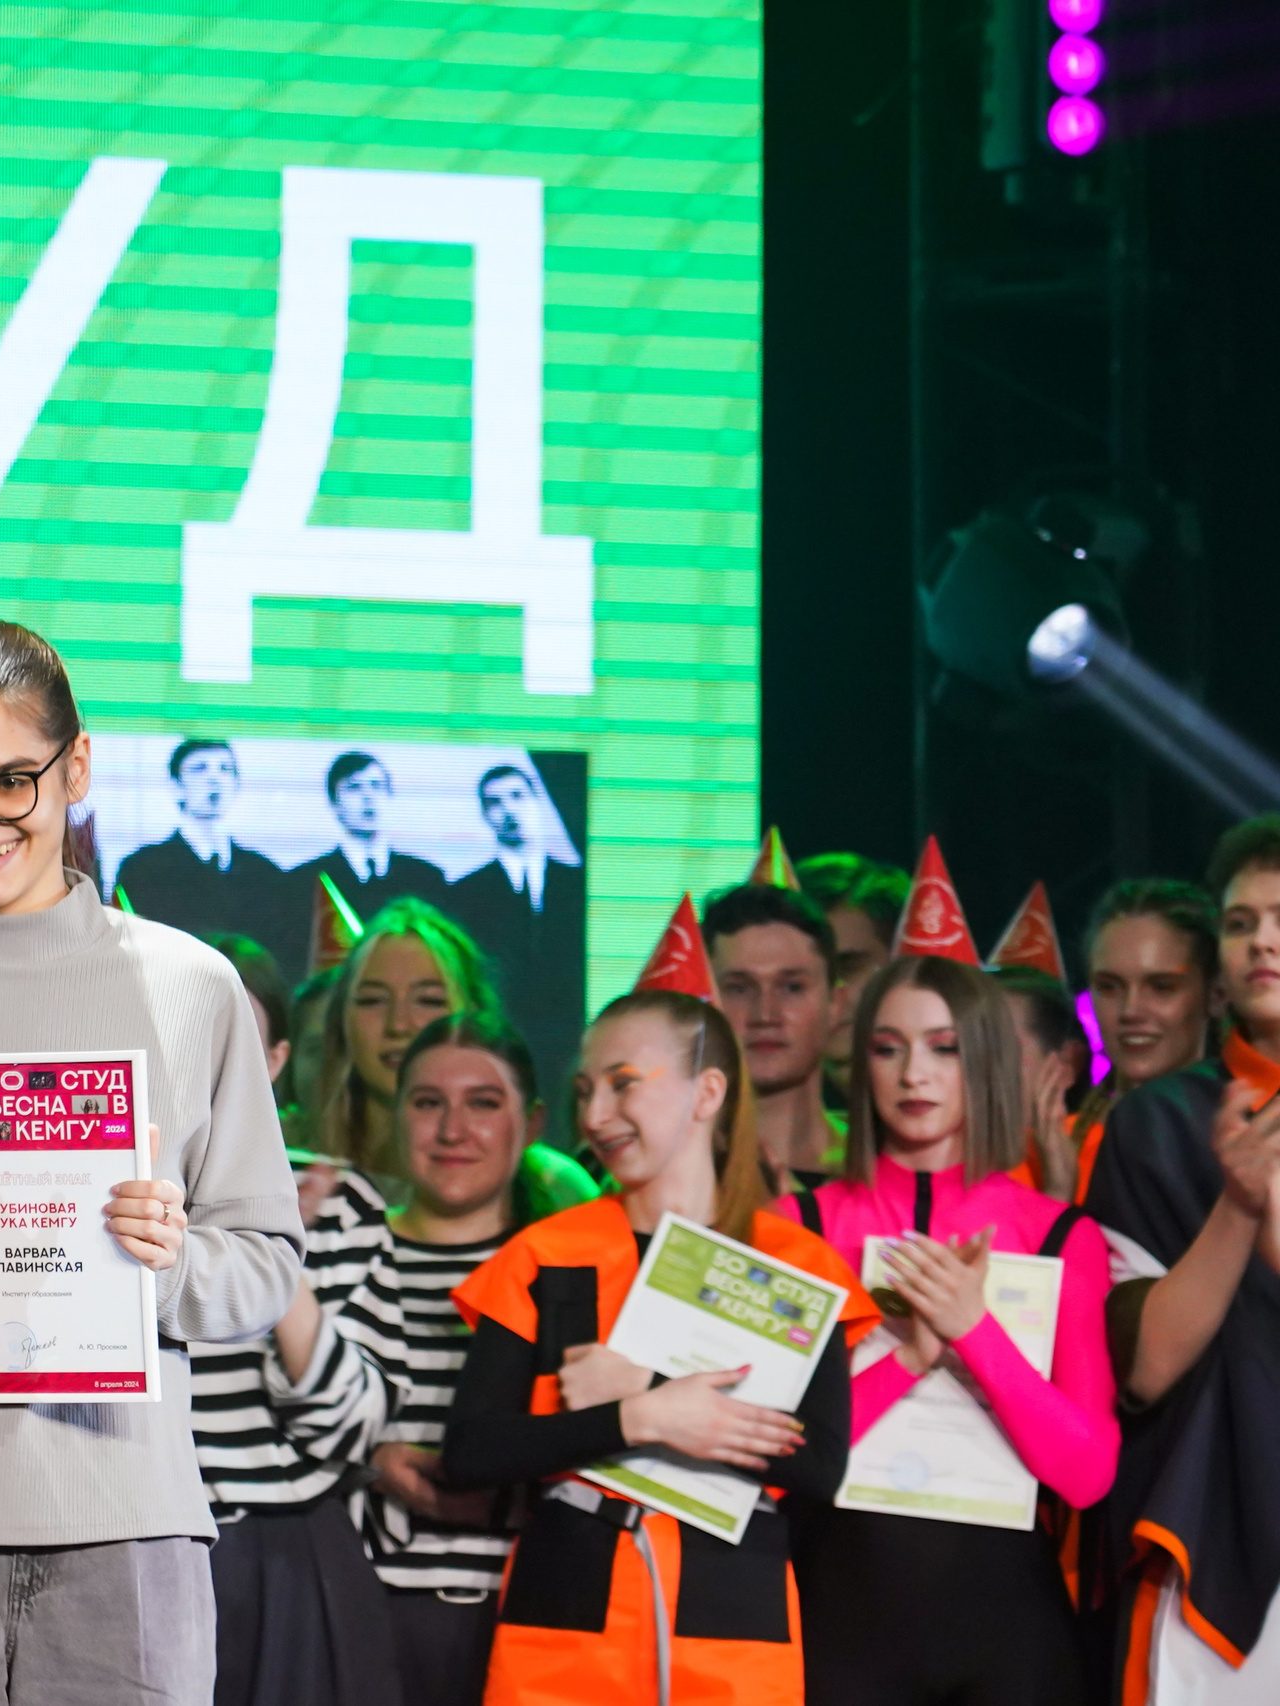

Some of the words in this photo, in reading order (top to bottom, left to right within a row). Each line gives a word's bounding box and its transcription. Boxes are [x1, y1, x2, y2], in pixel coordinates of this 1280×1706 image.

[60, 1069, 127, 1094] СТУД
[113, 1094, 128, 1115] В
[105, 1125, 126, 1134] 2024
[55, 1173, 93, 1186] ЗНАК
[31, 1217, 77, 1229] КЕМГУ
[4, 1247, 66, 1259] ВАРВАРА
[1, 1290, 30, 1298] Институт
[31, 1290, 73, 1298] образования
[96, 1343, 128, 1352] Просеков
[100, 1381, 123, 1389] апреля
[123, 1380, 140, 1388] 2024
